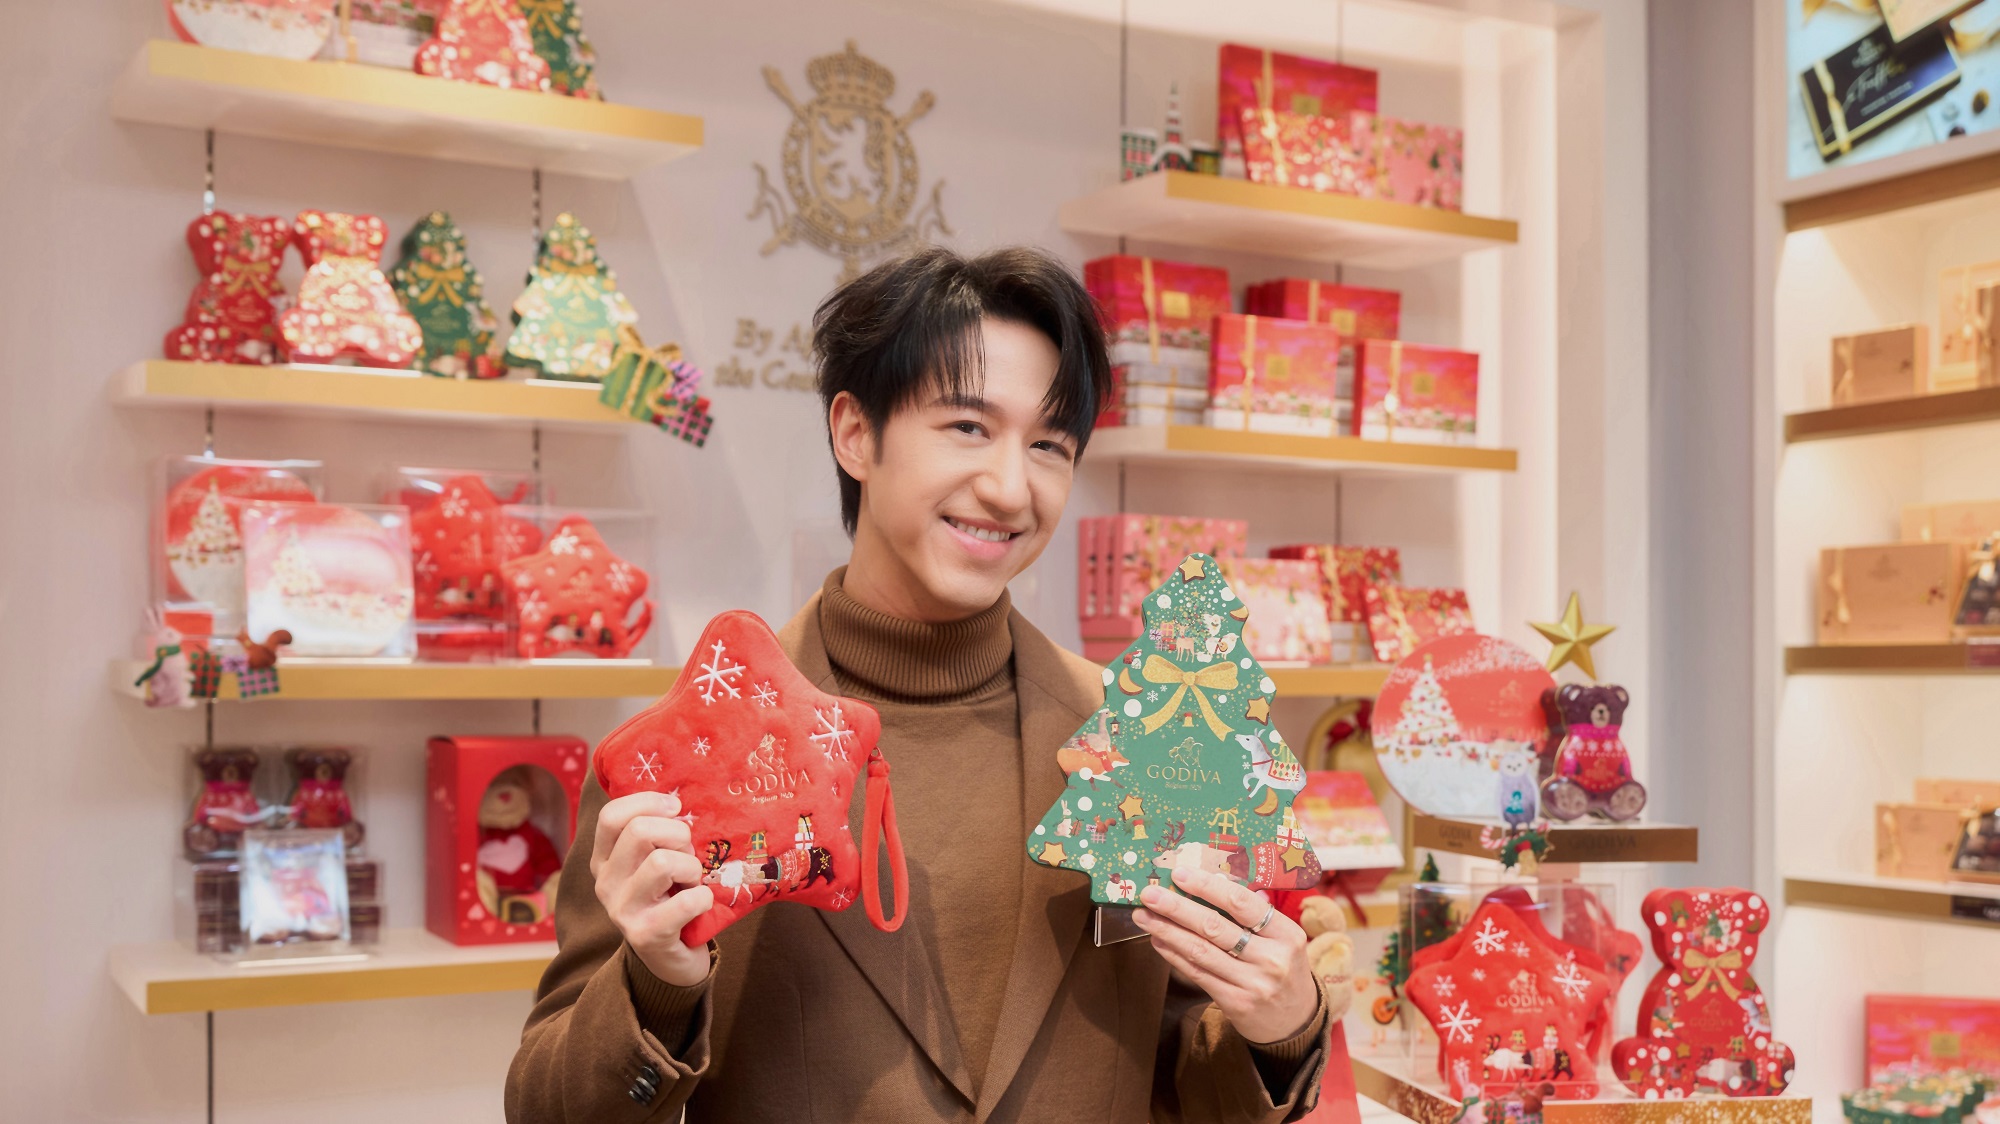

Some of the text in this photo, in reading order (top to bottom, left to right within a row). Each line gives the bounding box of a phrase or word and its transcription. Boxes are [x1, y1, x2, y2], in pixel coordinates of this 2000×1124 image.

[733, 318, 774, 357] By
[727, 767, 811, 795] GODIVA
[1146, 763, 1222, 785] GODIVA
[1496, 993, 1555, 1009] GODIVA
